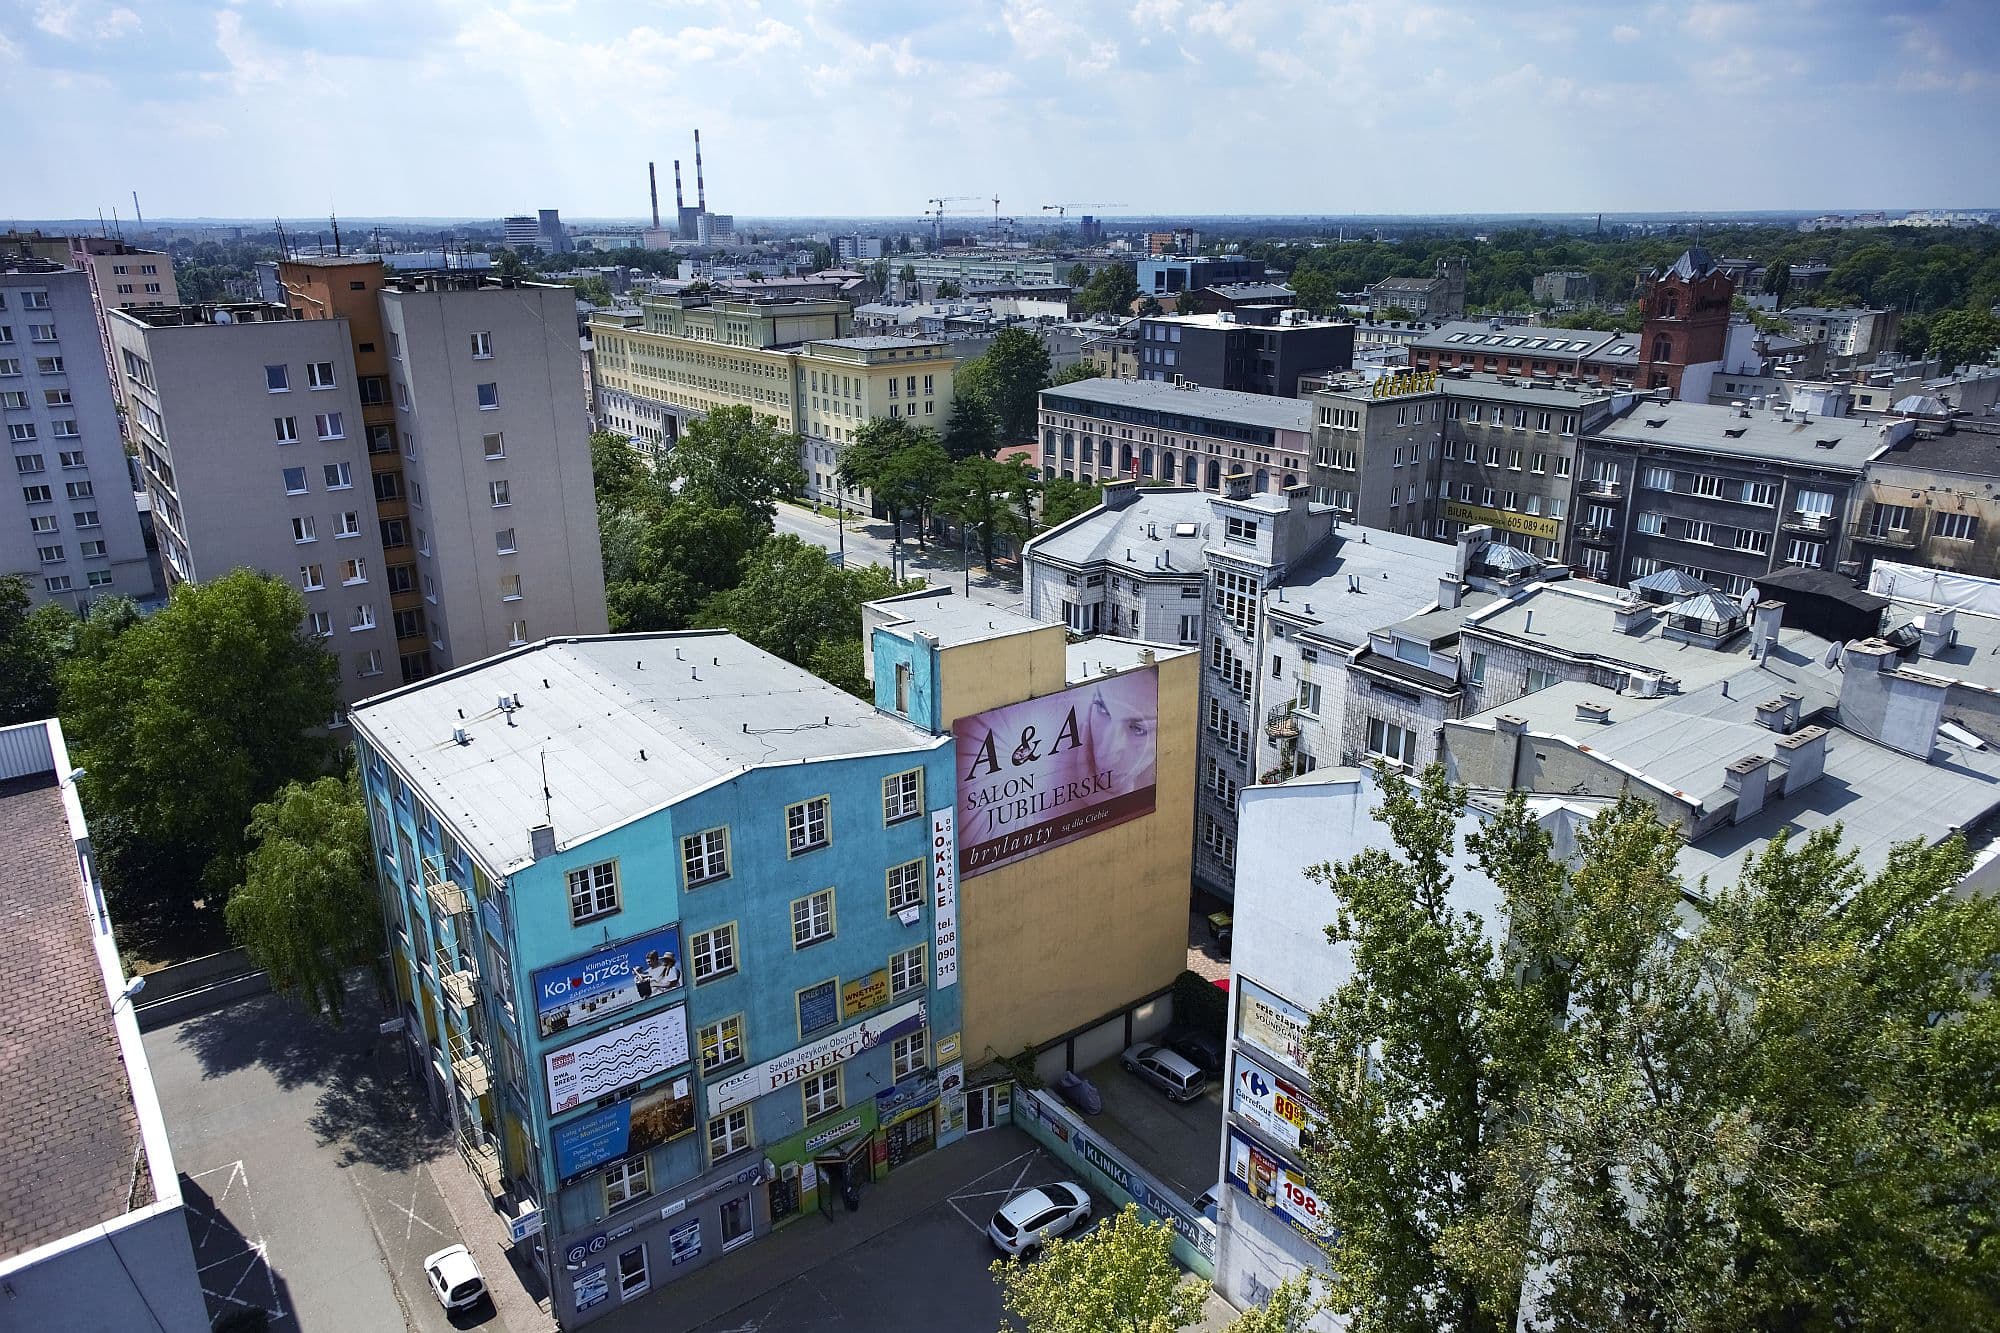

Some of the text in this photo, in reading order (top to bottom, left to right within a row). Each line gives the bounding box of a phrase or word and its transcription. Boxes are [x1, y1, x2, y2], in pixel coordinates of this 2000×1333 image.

[1447, 506, 1473, 519] BIURA
[1507, 517, 1521, 529] 605
[1523, 520, 1538, 531] 089
[1540, 523, 1554, 534] 414
[967, 773, 1035, 811] SALON
[987, 770, 1113, 833] JUBILERSKI
[945, 818, 951, 832] DO
[970, 825, 1054, 865] brylanty
[1085, 809, 1110, 824] Ciebie
[934, 821, 946, 908] LOKALE
[938, 917, 953, 931] tel.
[937, 932, 955, 946] 608
[585, 952, 629, 972] Klimatyczny
[937, 947, 955, 961] 090
[938, 962, 956, 976] 313
[1256, 1002, 1274, 1017] eric
[1275, 1013, 1307, 1035] clapto
[769, 1058, 795, 1073] Szkoła
[830, 1031, 857, 1047] Obcych
[770, 1041, 859, 1089] PERFEKT
[553, 1072, 569, 1081] DWA
[554, 1075, 577, 1087] BRZEGI
[1236, 1088, 1272, 1117] Carrefour
[1087, 1145, 1198, 1240] KLINIKA LAPTOPA
